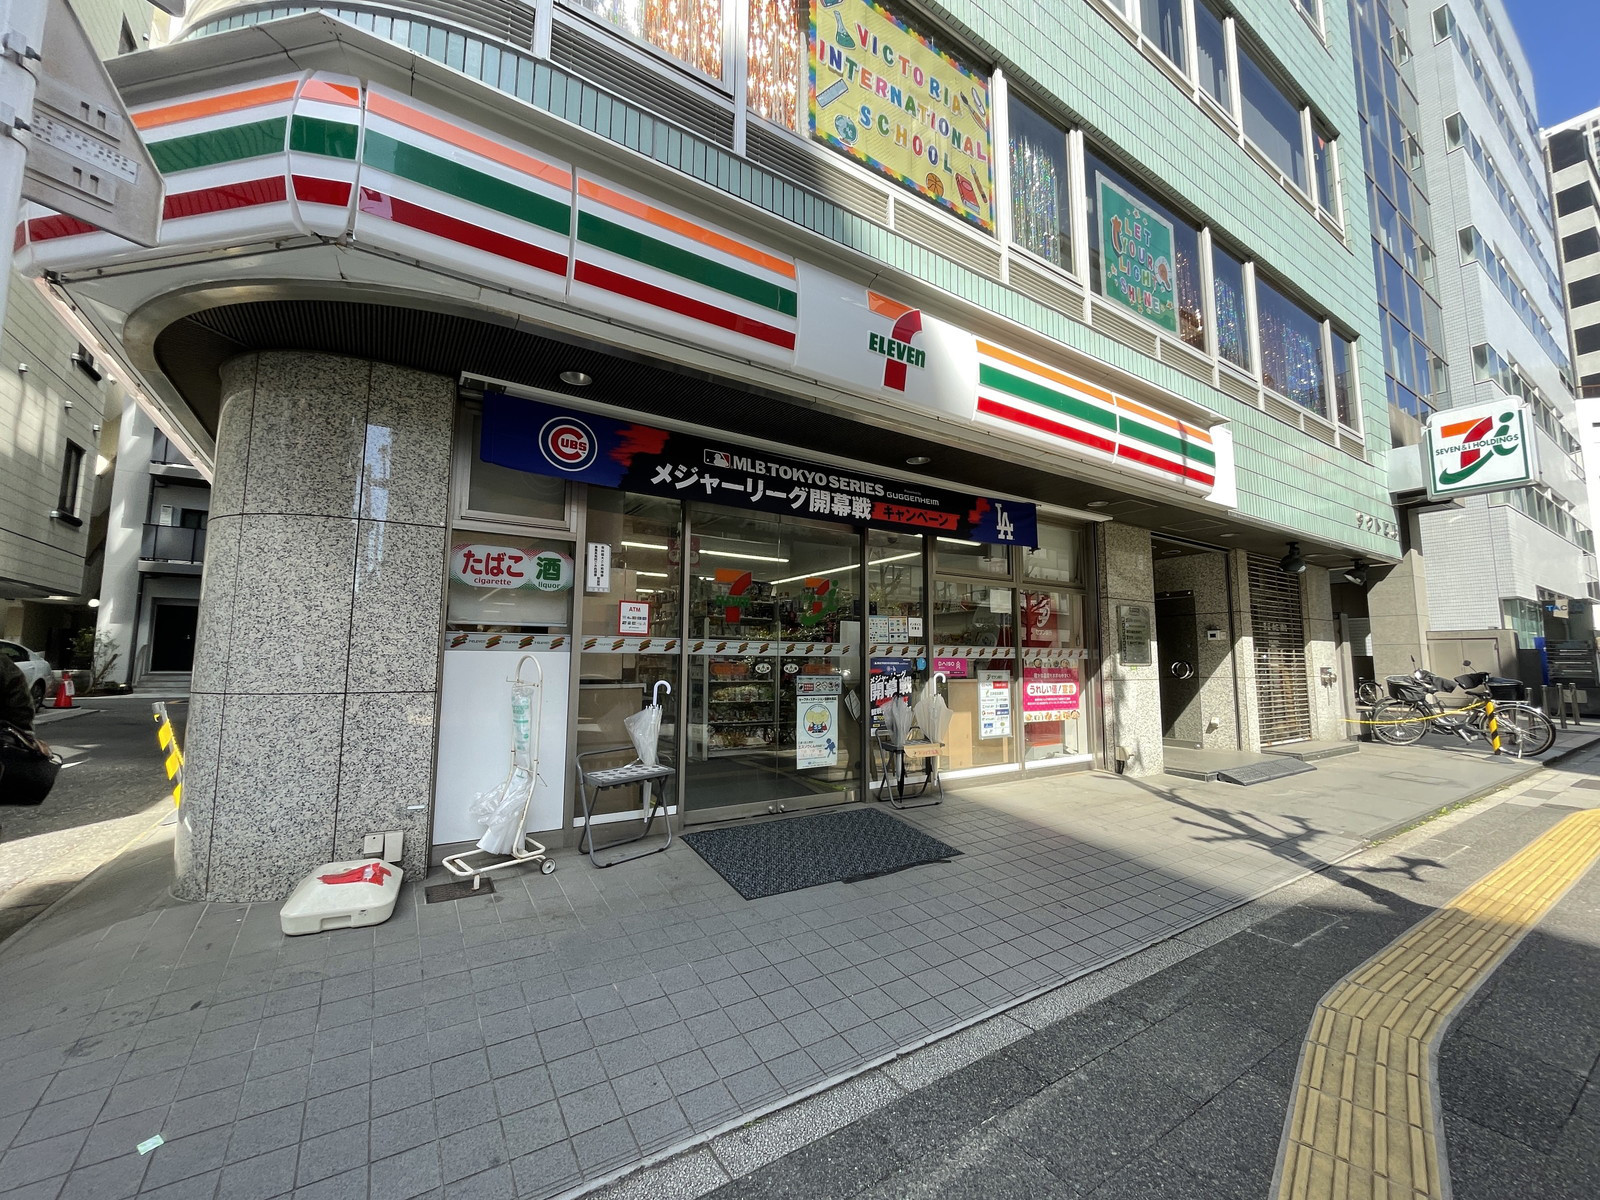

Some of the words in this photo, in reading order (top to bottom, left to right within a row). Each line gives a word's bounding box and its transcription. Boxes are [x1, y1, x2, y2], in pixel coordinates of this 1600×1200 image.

[856, 23, 963, 117] VICTORIA
[819, 40, 987, 163] INTERNATIONAL
[858, 105, 953, 175] SCHOOL
[1125, 217, 1151, 247] LET
[1121, 236, 1154, 271] YOUR
[1120, 277, 1160, 314] SHINE
[1472, 433, 1520, 449] HOLDINGS
[651, 463, 873, 521] メジャーリーグ開幕戦
[733, 455, 767, 475] MLB
[768, 463, 827, 487] TOKYO
[828, 475, 885, 497] SERIES
[883, 507, 949, 528] キャンペーン
[994, 502, 1015, 541] LA
[461, 549, 525, 578] たばこ
[536, 556, 562, 582] 酒
[474, 577, 512, 587] cigarette
[538, 581, 561, 590] liquor
[1545, 604, 1568, 612] TAC
